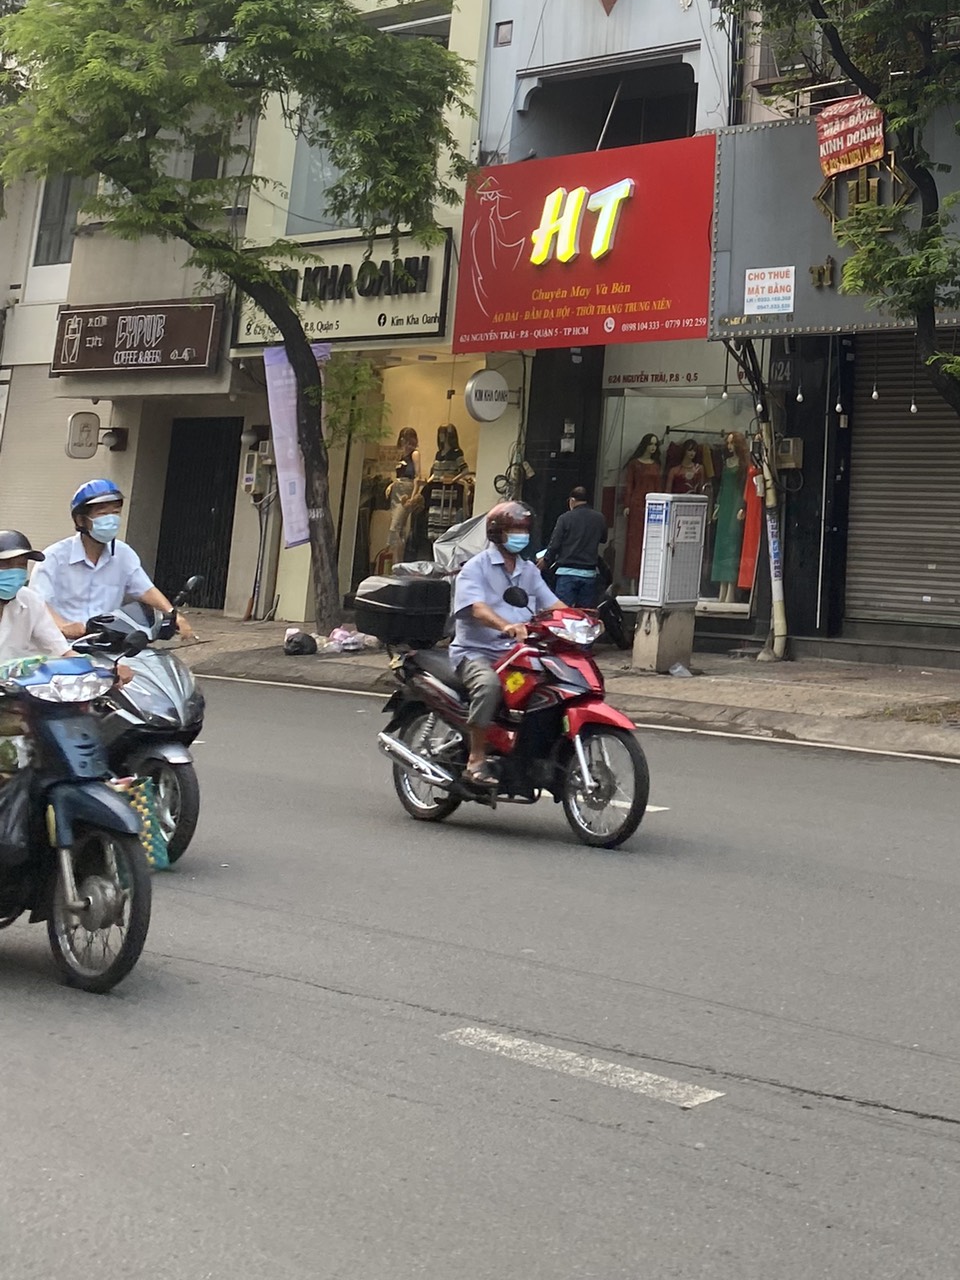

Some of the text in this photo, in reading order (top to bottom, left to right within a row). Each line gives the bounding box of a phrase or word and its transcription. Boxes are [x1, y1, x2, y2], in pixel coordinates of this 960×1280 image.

[820, 123, 883, 157] KINH DOANH
[529, 167, 636, 266] HT
[747, 268, 791, 281] CHO THUÊ
[301, 263, 354, 302] KHA
[747, 281, 792, 297] MẶT BẰNG
[532, 282, 631, 301] Chuyên May Và Bán
[596, 303, 622, 315] TRANG
[624, 301, 651, 313] TRUNG
[335, 320, 340, 330] 5
[391, 312, 440, 326] Kim Kha Oanh
[648, 321, 660, 330] 333
[665, 320, 681, 329] 0779
[682, 318, 694, 327] 192
[694, 317, 707, 327] 259
[563, 327, 573, 336] TP
[573, 326, 589, 335] HCM
[608, 374, 621, 384] 624
[622, 370, 649, 383] NGUYỄN
[669, 373, 680, 382] P.8
[686, 372, 698, 383] Q.5
